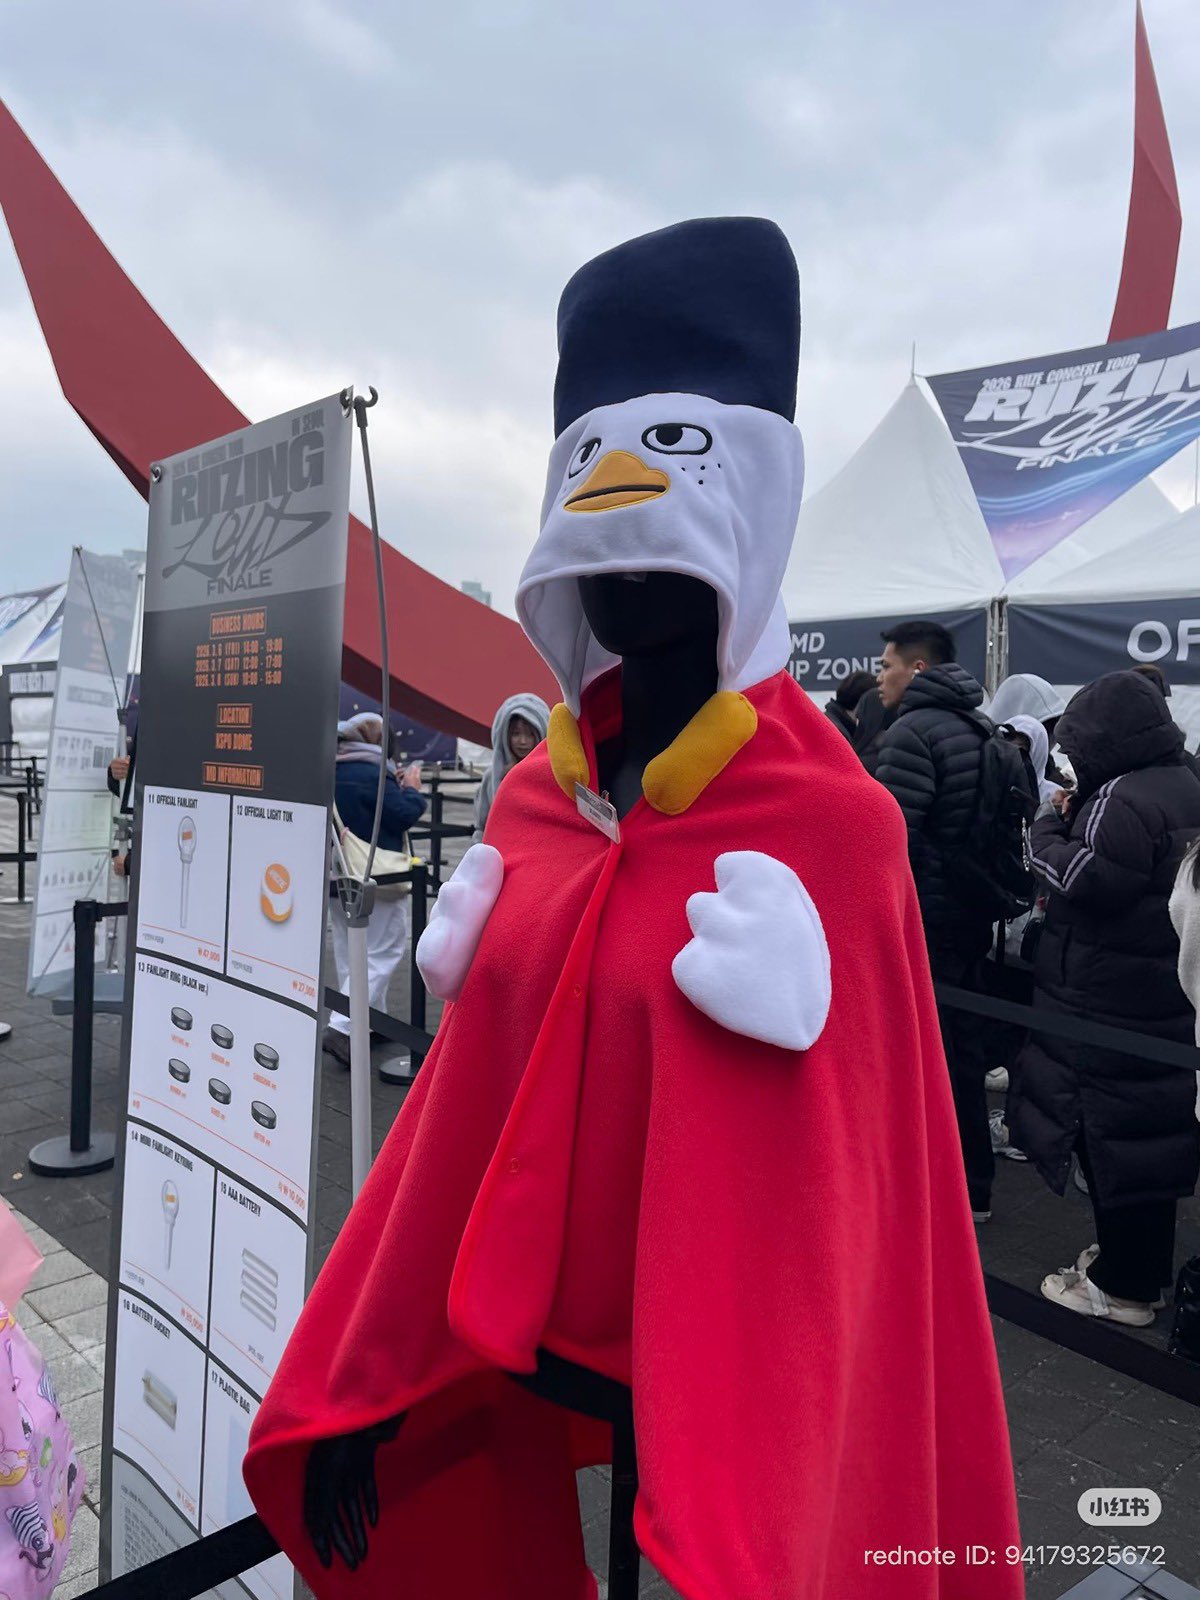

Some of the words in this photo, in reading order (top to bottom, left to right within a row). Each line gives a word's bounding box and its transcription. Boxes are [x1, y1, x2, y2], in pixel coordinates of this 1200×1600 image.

[982, 376, 1012, 392] 2026
[1046, 361, 1103, 384] CONCERT
[1105, 352, 1141, 372] TOUR
[1016, 431, 1168, 470] FINALE
[207, 568, 272, 597] FINALE
[212, 614, 241, 635] BUSINESS
[242, 612, 264, 631] HOURS
[791, 632, 825, 653] MD
[816, 656, 882, 680] ZONE
[220, 707, 250, 724] LOCATION
[216, 732, 232, 750] KSPO
[233, 733, 252, 751] DOME
[218, 766, 262, 786] INFORMATION
[148, 794, 155, 804] 11
[156, 794, 176, 807] OFFICIAL
[177, 796, 198, 809] FANLIGHT
[236, 805, 243, 815] 12
[244, 805, 266, 819] OFFICIAL
[267, 809, 282, 821] LIGHT
[138, 961, 145, 972] 13
[146, 963, 170, 980] FANLIGHT
[170, 970, 181, 984] RING
[181, 975, 198, 990] (BLACK
[131, 1130, 138, 1141] 14
[152, 1139, 174, 1160] FANLIGHT
[174, 1151, 193, 1172] KEYRING
[220, 1181, 227, 1195] 15
[227, 1185, 238, 1202] AAA
[239, 1193, 261, 1217] BATTERY
[123, 1299, 130, 1311] 16
[131, 1303, 153, 1325] BATTERY
[154, 1318, 170, 1339] SOCKET
[211, 1370, 218, 1384] 17
[218, 1377, 239, 1404] PLASTIC
[239, 1393, 250, 1414] BAG
